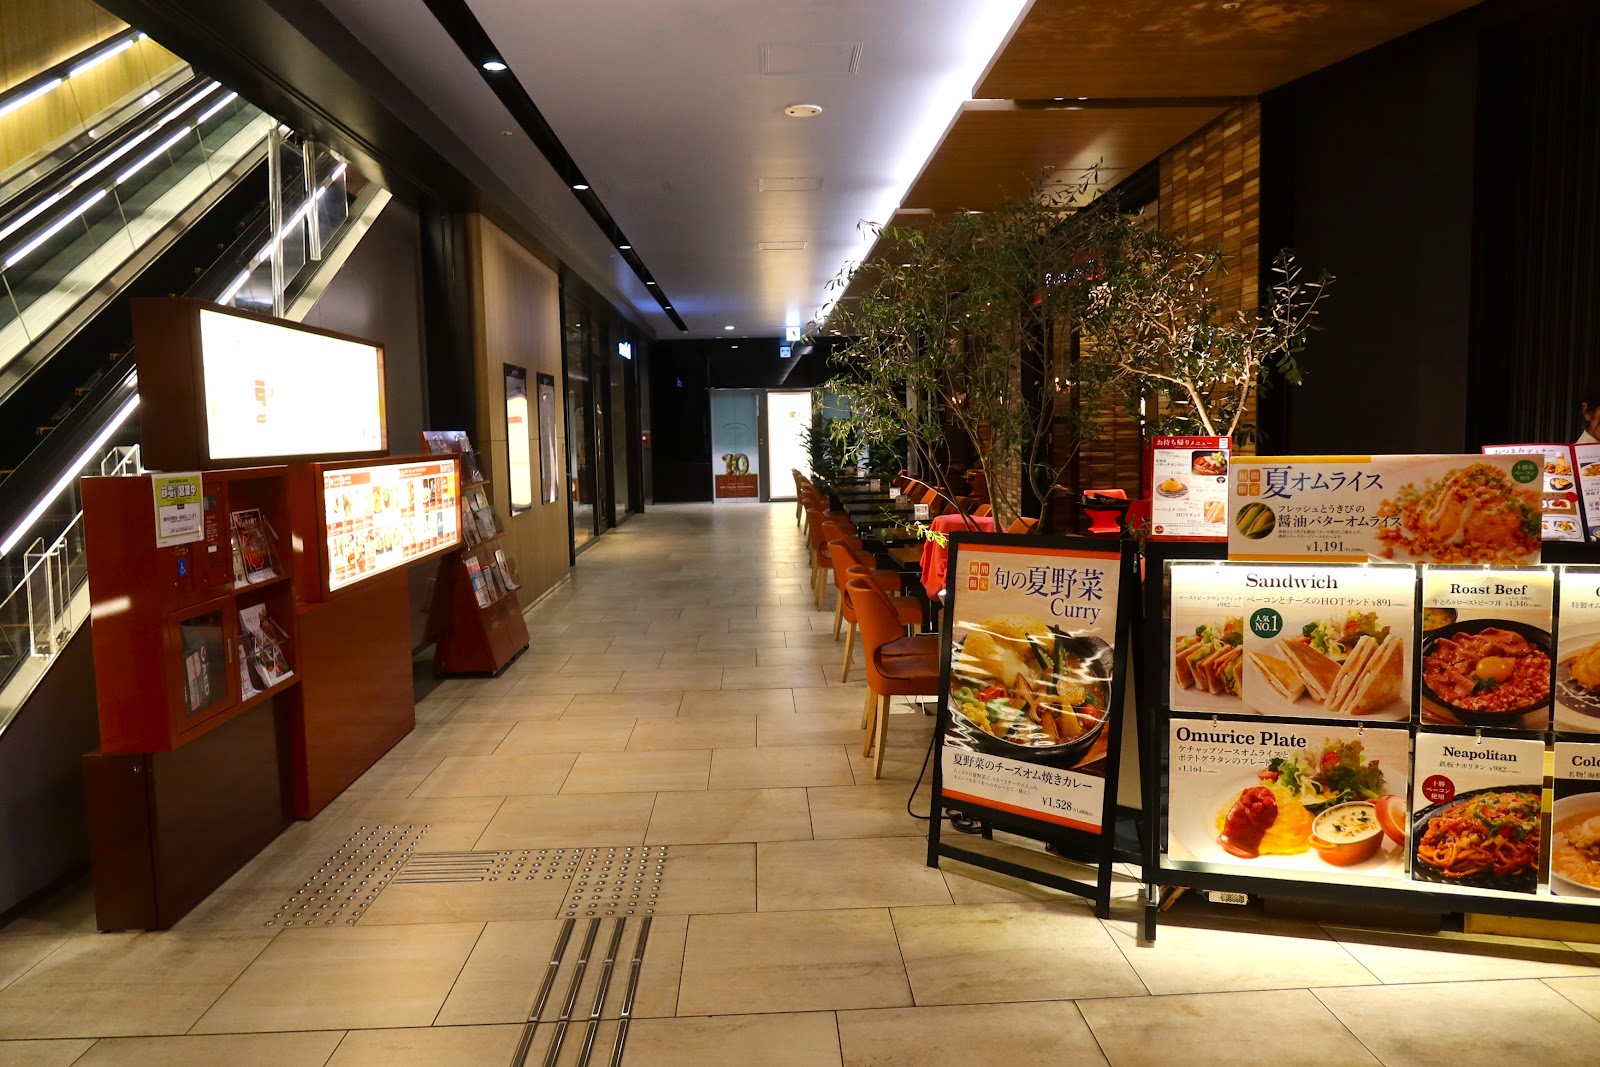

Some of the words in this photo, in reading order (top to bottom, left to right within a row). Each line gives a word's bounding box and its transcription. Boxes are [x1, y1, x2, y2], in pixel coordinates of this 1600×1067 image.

[1156, 438, 1213, 447] お持ち帰りメニュー
[722, 453, 749, 477] 10
[1262, 465, 1384, 499] 夏オムライス
[1277, 504, 1365, 513] フレッシュとうきびの
[1277, 514, 1402, 528] 醤油バターオムライス
[1306, 541, 1344, 553] ¥1,191
[970, 561, 990, 577] 期間
[969, 576, 989, 591] 限定
[994, 565, 1105, 601] 旬の夏野菜
[1245, 573, 1339, 589] Sandwich
[1450, 583, 1491, 595] Roast
[1494, 584, 1528, 595] Beef
[1371, 598, 1392, 607] ¥891
[1050, 598, 1101, 625] Curry
[1255, 615, 1270, 623] 人気
[1176, 726, 1255, 746] Omurice
[1259, 731, 1307, 749] Plate
[1178, 744, 1289, 759] ケチャップソースオムライスと
[1443, 746, 1518, 763] Neapolitan
[952, 753, 1093, 789] 夏野菜のチーズオム焼きカレー
[1438, 761, 1486, 770] 鉄板ナポリタン
[1042, 797, 1073, 811] ¥1,528
